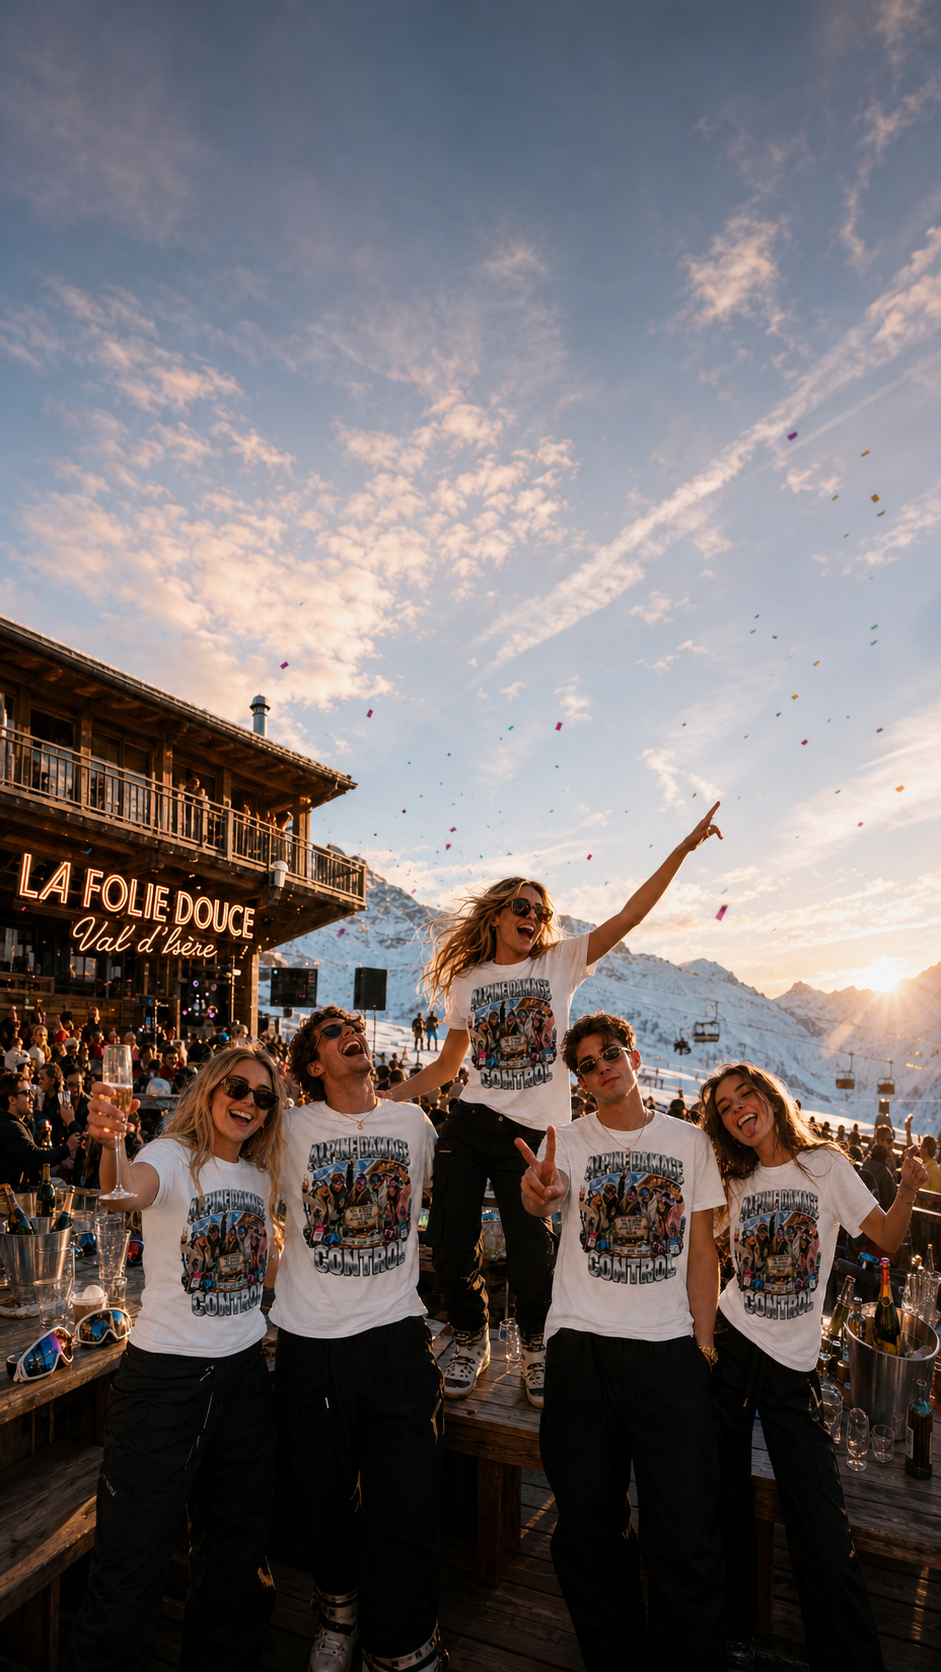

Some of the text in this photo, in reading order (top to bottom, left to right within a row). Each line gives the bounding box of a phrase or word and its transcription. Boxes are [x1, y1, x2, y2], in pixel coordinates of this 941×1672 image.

[19, 853, 256, 939] LA FOLIE DOUCE
[72, 916, 134, 951] Val
[480, 1062, 553, 1090] CONTROL
[307, 1137, 358, 1172] ALPINE
[584, 1151, 684, 1185] ALPINE DAMAGE
[313, 1240, 406, 1277] CONTROL
[587, 1251, 677, 1284] CONTROL
[190, 1283, 264, 1317] CONTROL
[742, 1288, 814, 1320] CONTROL
